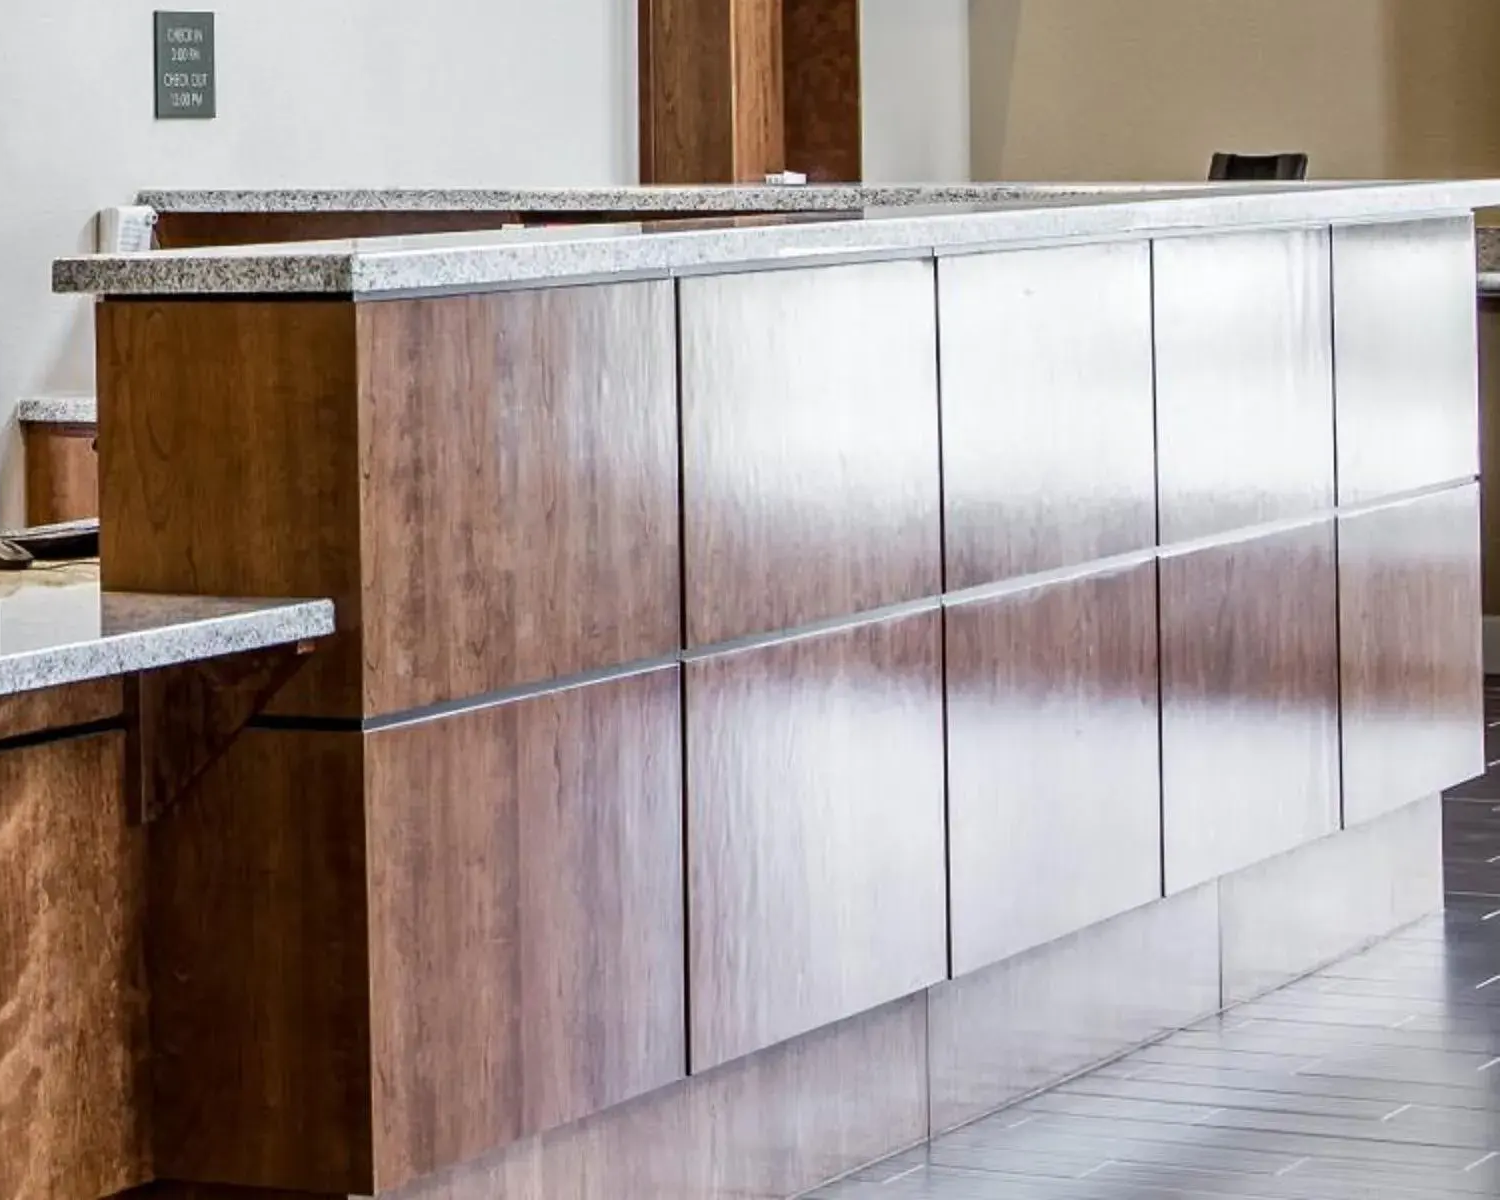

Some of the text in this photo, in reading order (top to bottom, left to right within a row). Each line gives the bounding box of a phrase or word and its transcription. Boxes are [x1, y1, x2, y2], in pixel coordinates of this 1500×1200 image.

[166, 27, 193, 43] CHECK
[163, 72, 208, 88] CHECK OUT
[191, 92, 203, 107] PM
